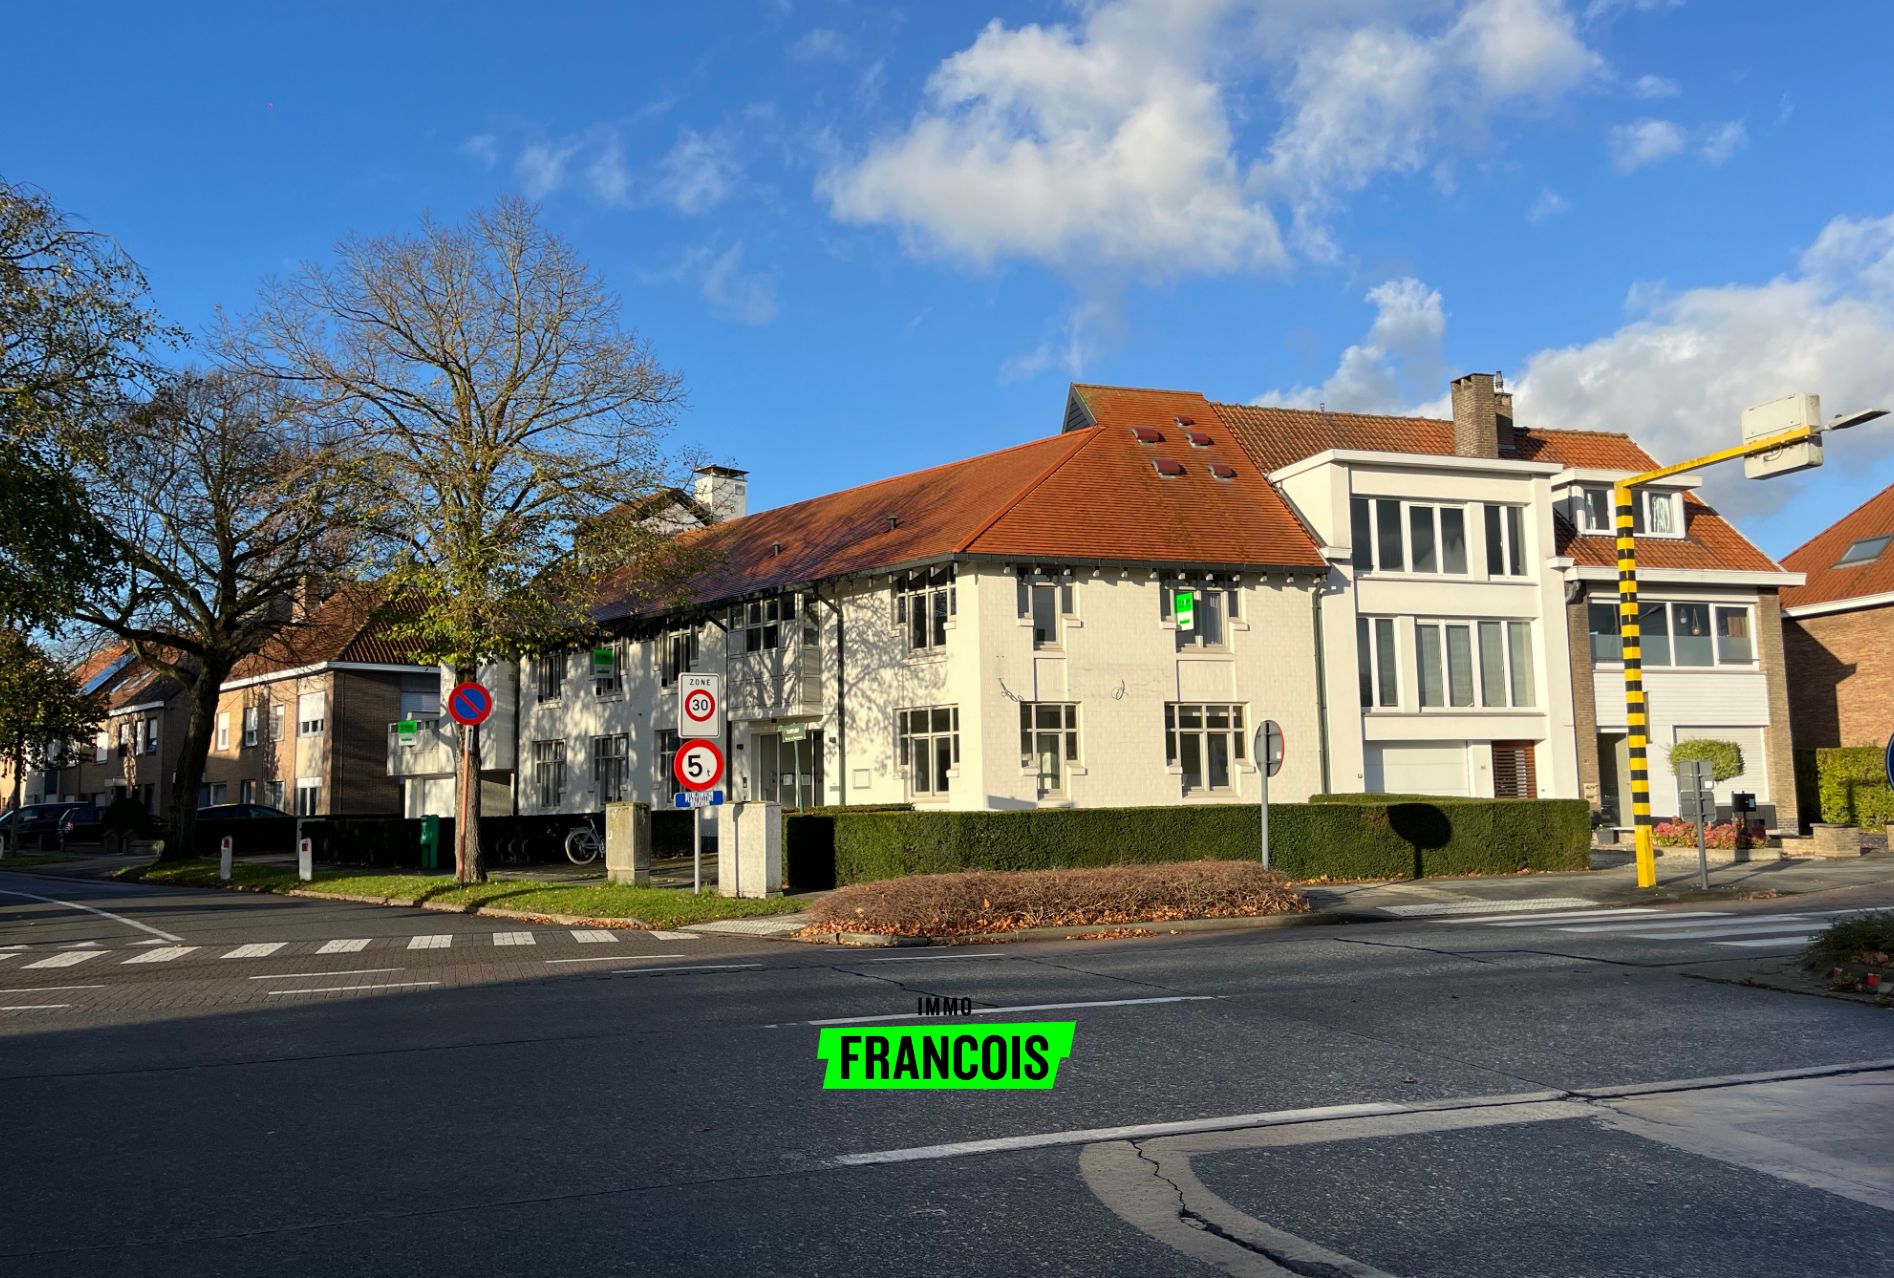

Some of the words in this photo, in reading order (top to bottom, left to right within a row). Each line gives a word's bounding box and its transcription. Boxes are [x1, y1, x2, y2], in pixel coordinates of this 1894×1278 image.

[689, 678, 711, 686] ZONE
[692, 699, 709, 711] 30
[688, 755, 703, 777] 5
